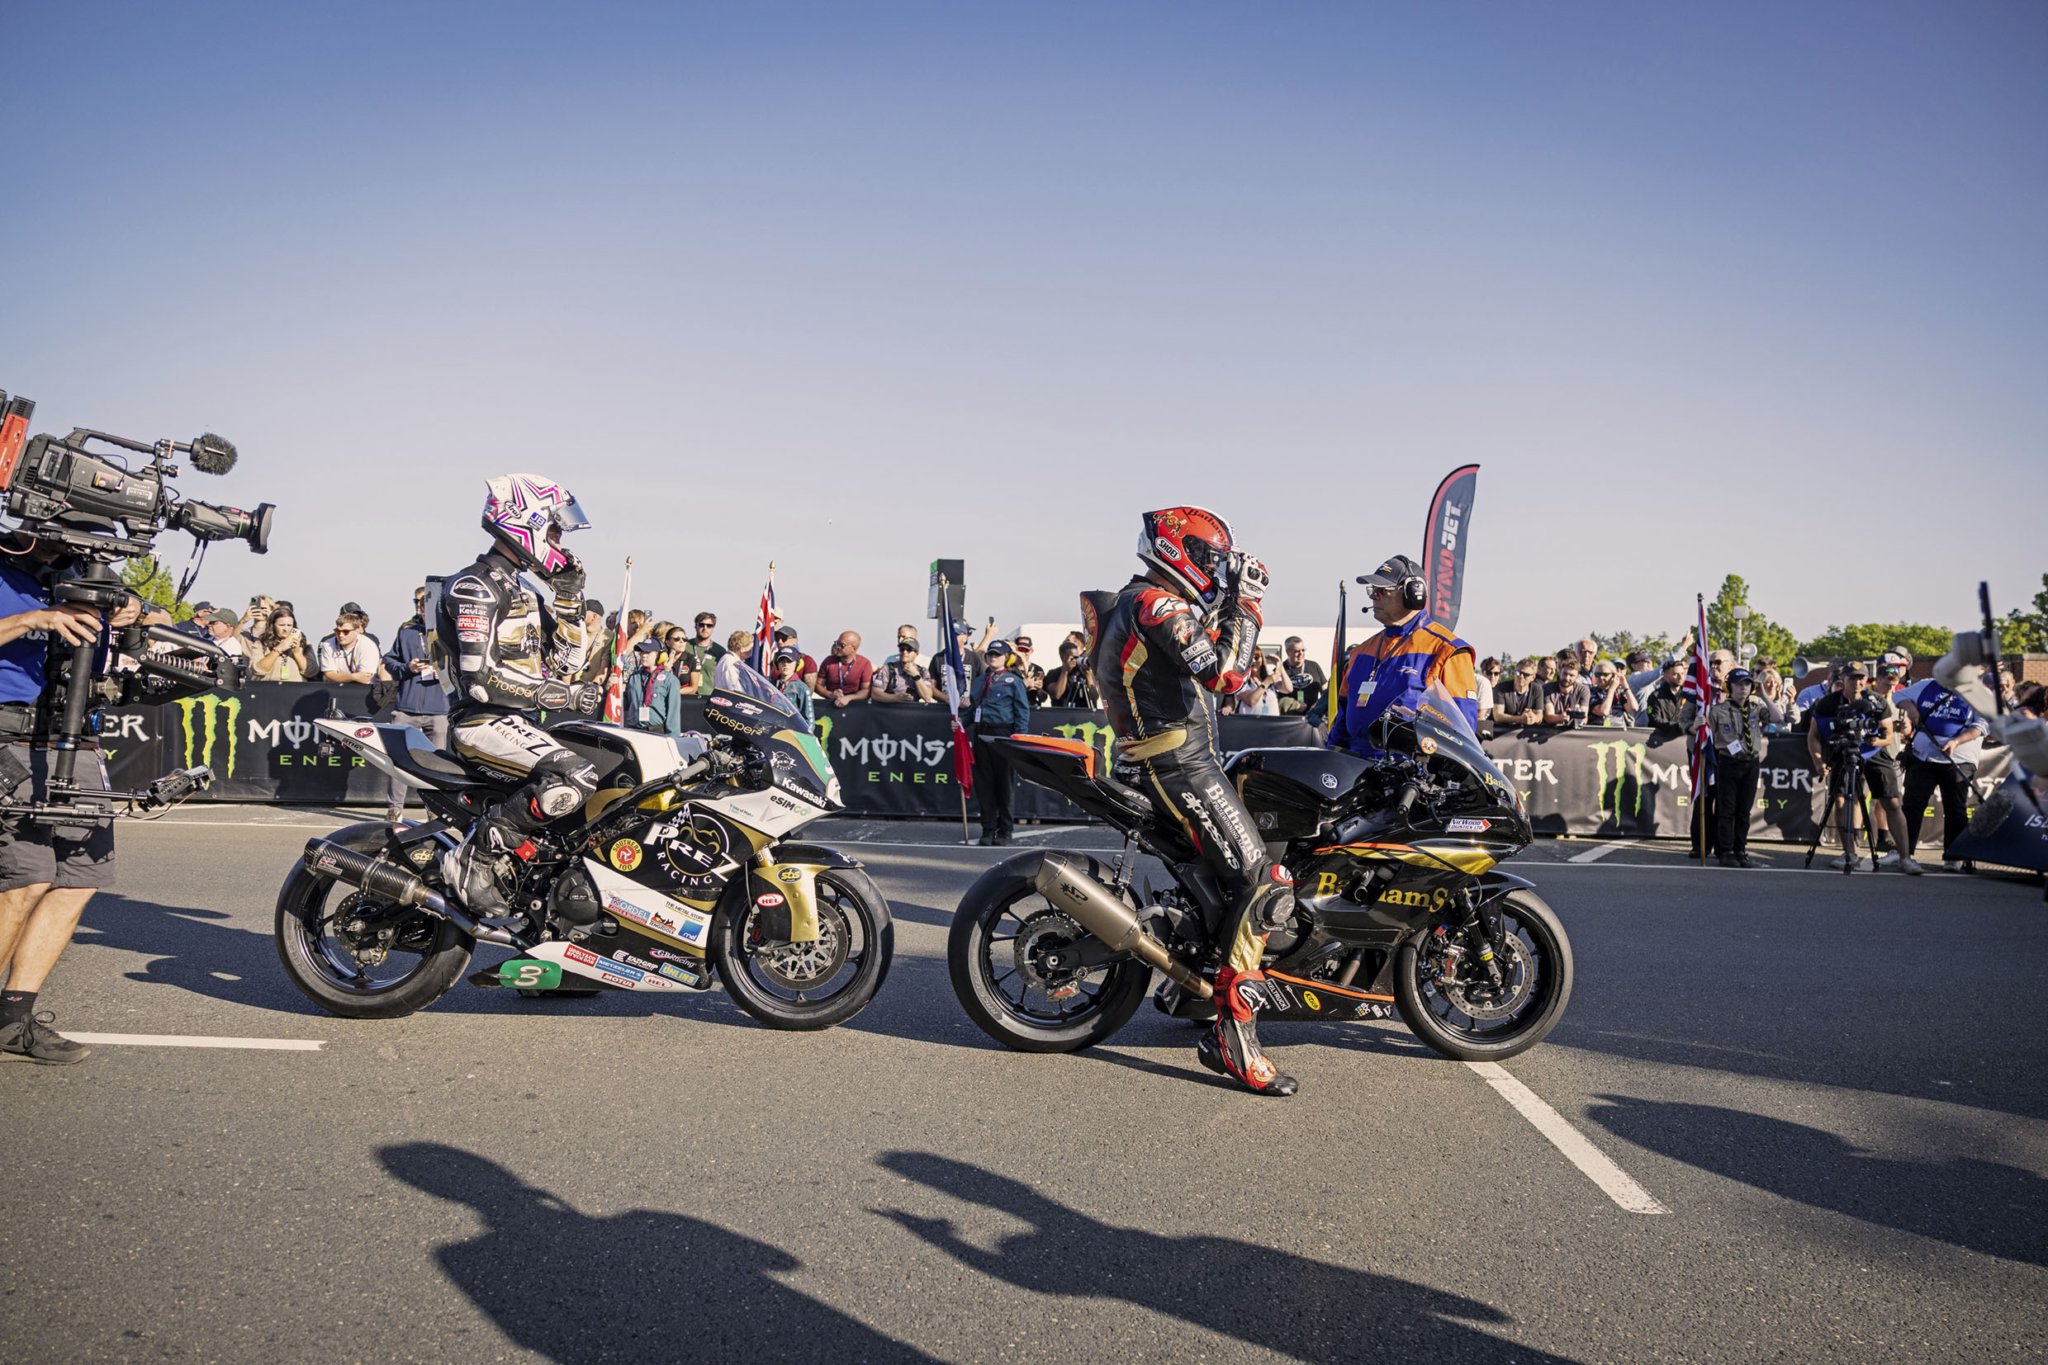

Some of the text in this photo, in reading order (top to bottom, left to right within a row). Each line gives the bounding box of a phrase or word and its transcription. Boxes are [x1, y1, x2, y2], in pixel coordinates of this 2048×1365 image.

[531, 513, 545, 525] JB
[1158, 539, 1179, 559] SHOEI
[1434, 500, 1461, 620] DYNOJET
[495, 726, 527, 750] RACING
[782, 778, 828, 808] Kawasaki
[1181, 791, 1240, 871] alpinestars
[612, 840, 641, 855] SOUTHERN
[643, 822, 741, 882] PREZ
[618, 863, 633, 871] 100
[656, 851, 713, 887] RACING
[611, 897, 650, 920] KORDEL
[513, 964, 543, 987] 3
[603, 974, 634, 988] MOTUL
[1266, 981, 1287, 1010] KELTRUCK
